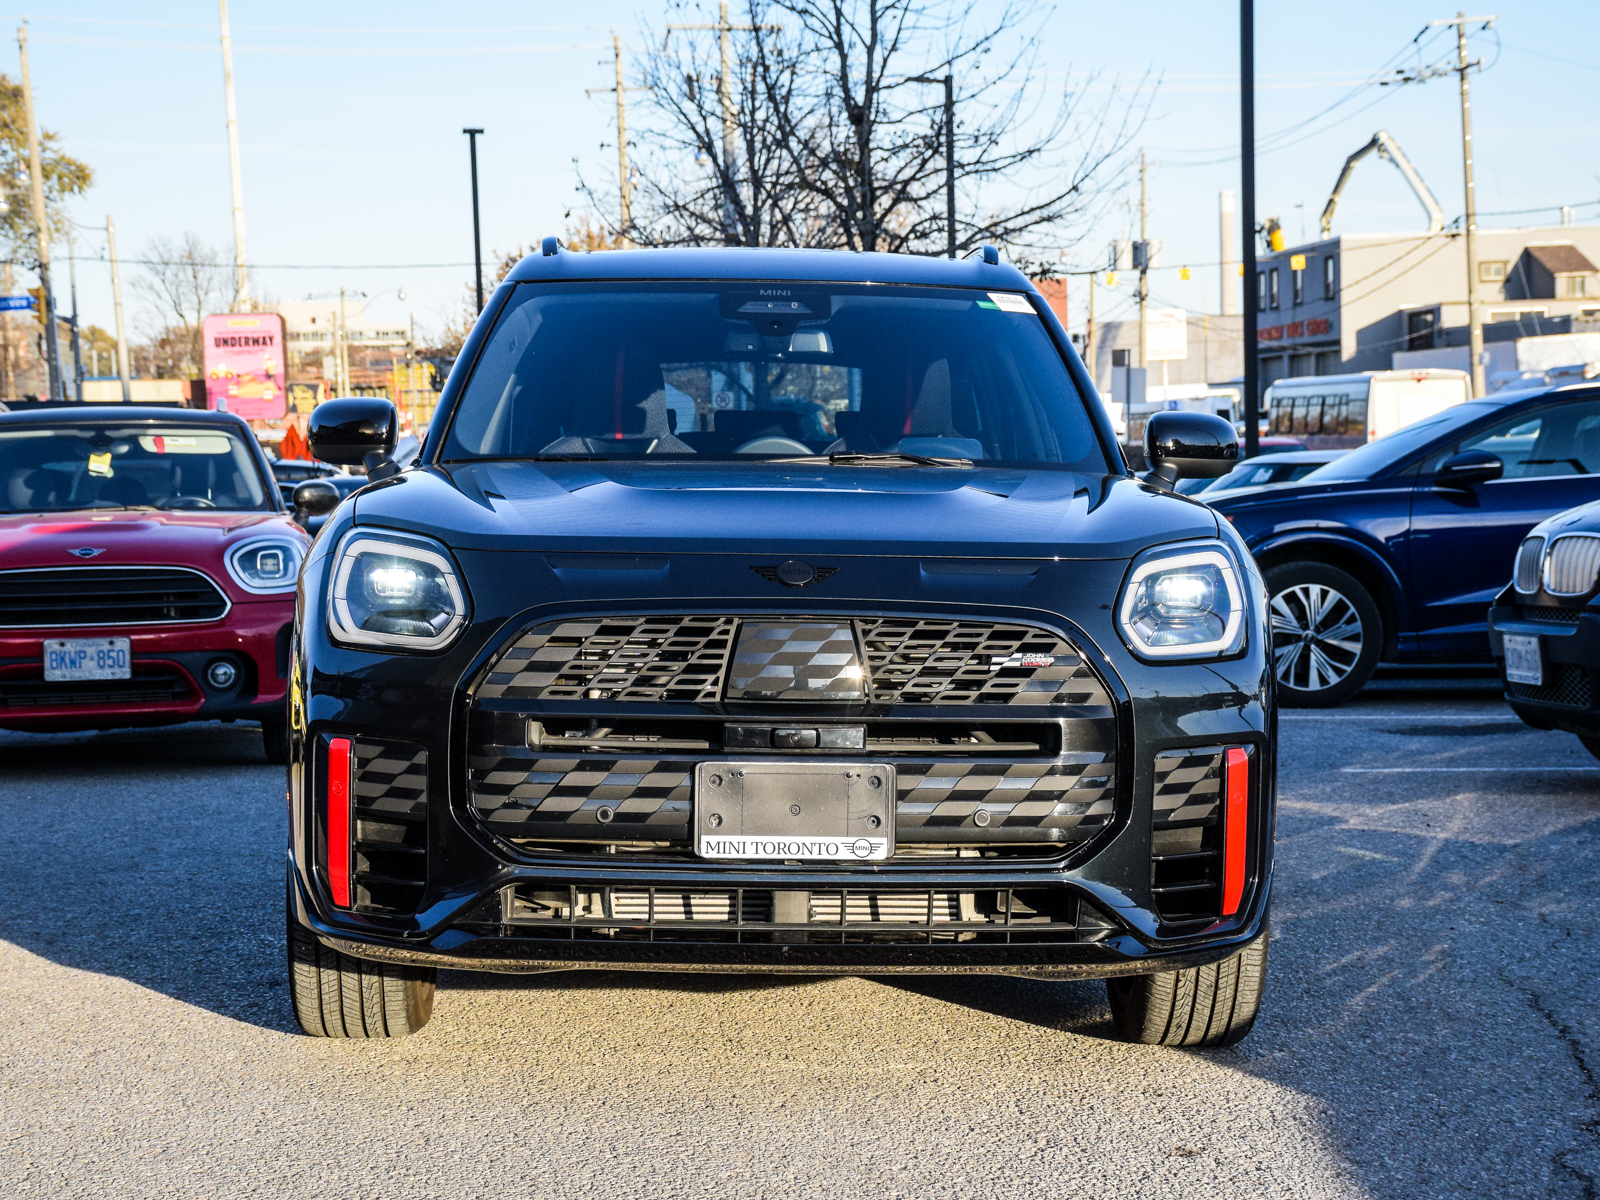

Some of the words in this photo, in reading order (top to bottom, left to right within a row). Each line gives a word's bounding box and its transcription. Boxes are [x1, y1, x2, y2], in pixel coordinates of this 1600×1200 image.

[214, 334, 275, 348] UNDERWAY
[780, 568, 811, 576] MINI
[49, 649, 88, 670] BKWP
[97, 649, 126, 669] 850
[704, 840, 748, 855] MINI
[751, 841, 840, 856] TORONTO
